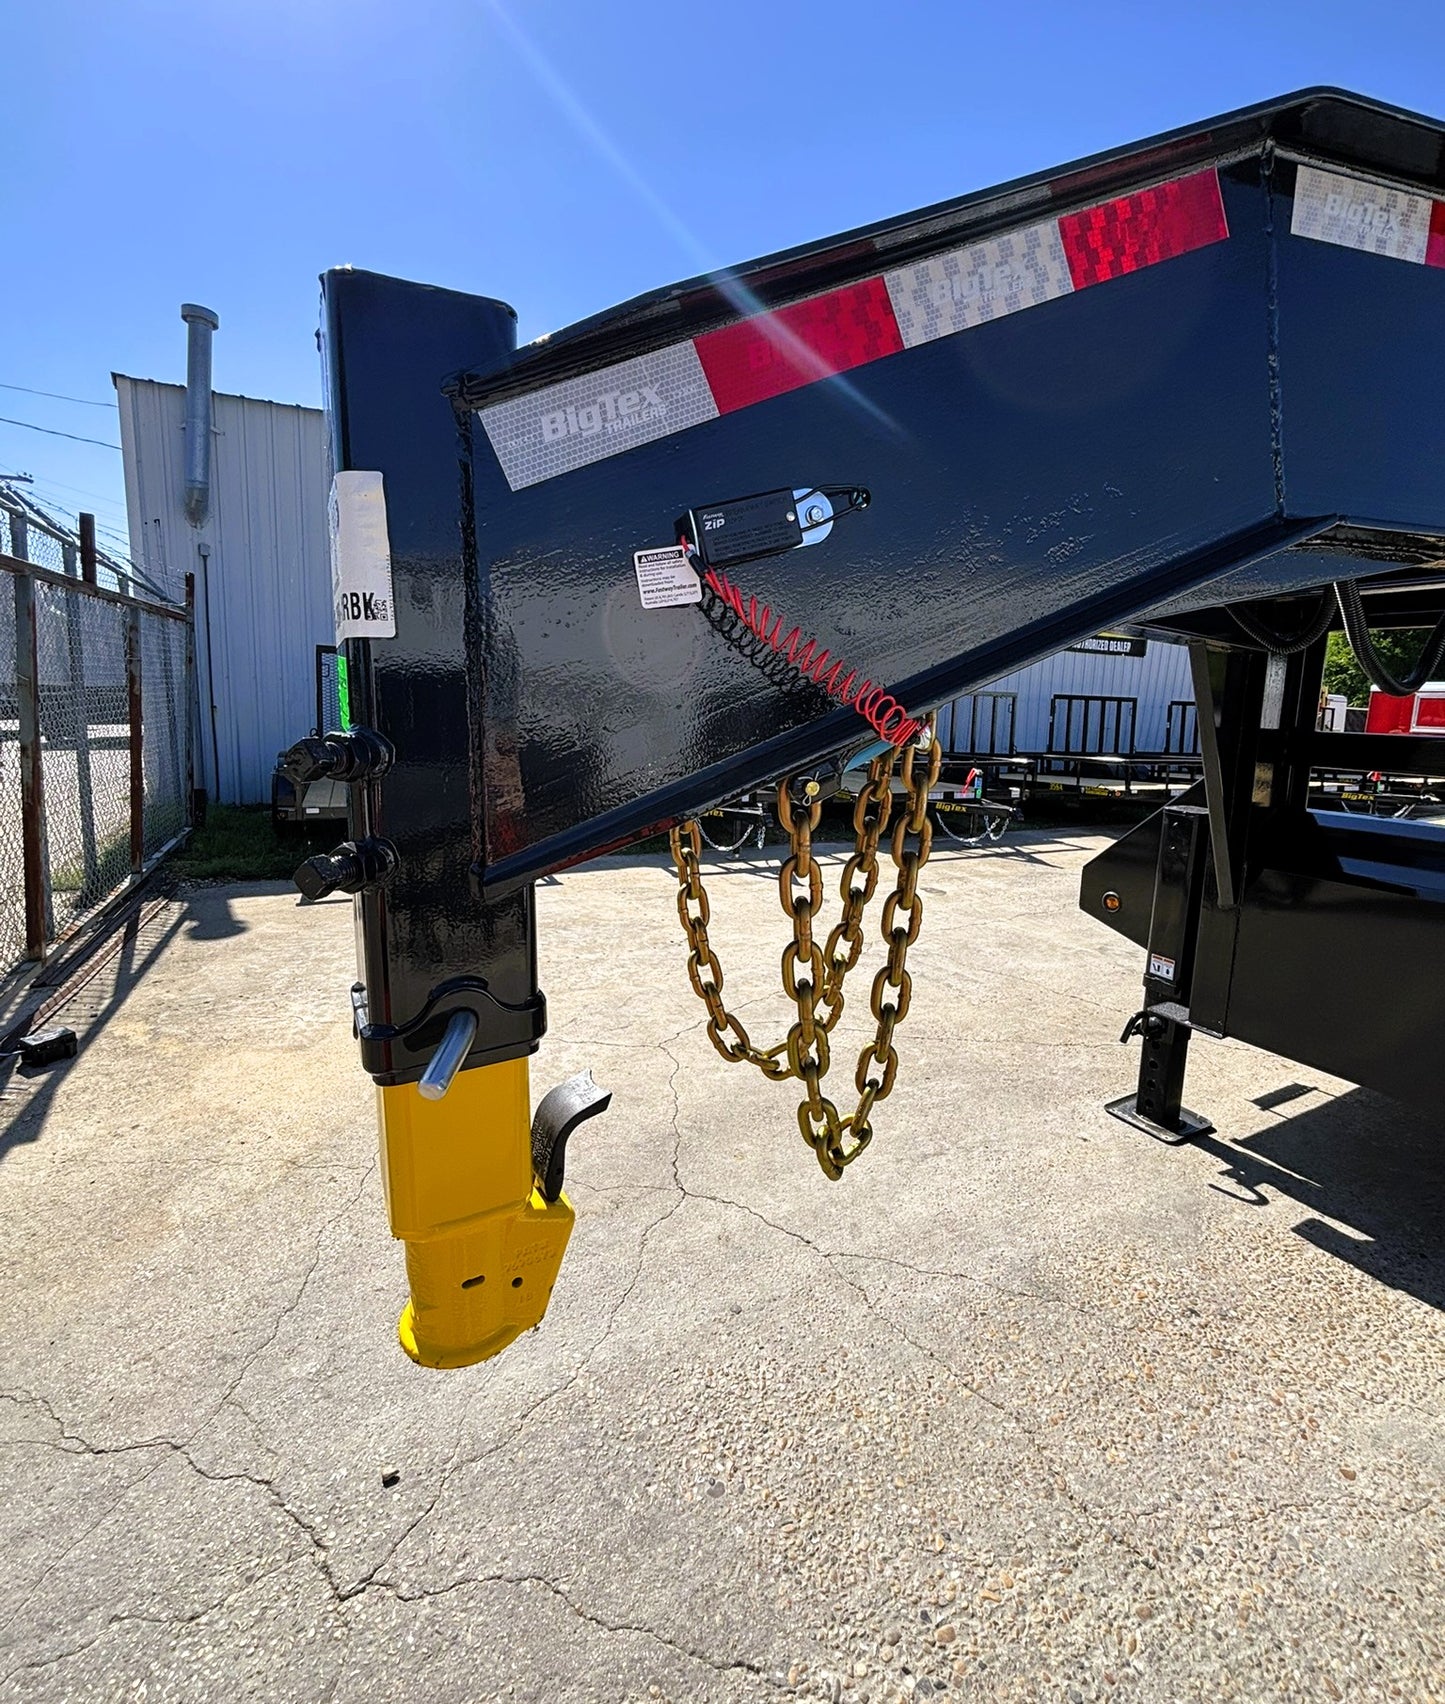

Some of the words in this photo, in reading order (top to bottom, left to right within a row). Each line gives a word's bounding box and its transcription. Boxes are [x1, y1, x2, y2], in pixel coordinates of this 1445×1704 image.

[1325, 193, 1403, 230] BigTex
[541, 382, 667, 443] BigTex
[606, 402, 668, 435] TRAILERS
[646, 551, 680, 562] WARNING
[1072, 638, 1109, 652] UTHORIZED
[1109, 640, 1131, 653] DEALER
[1341, 792, 1375, 801] BigTex
[935, 801, 967, 812] BigTex
